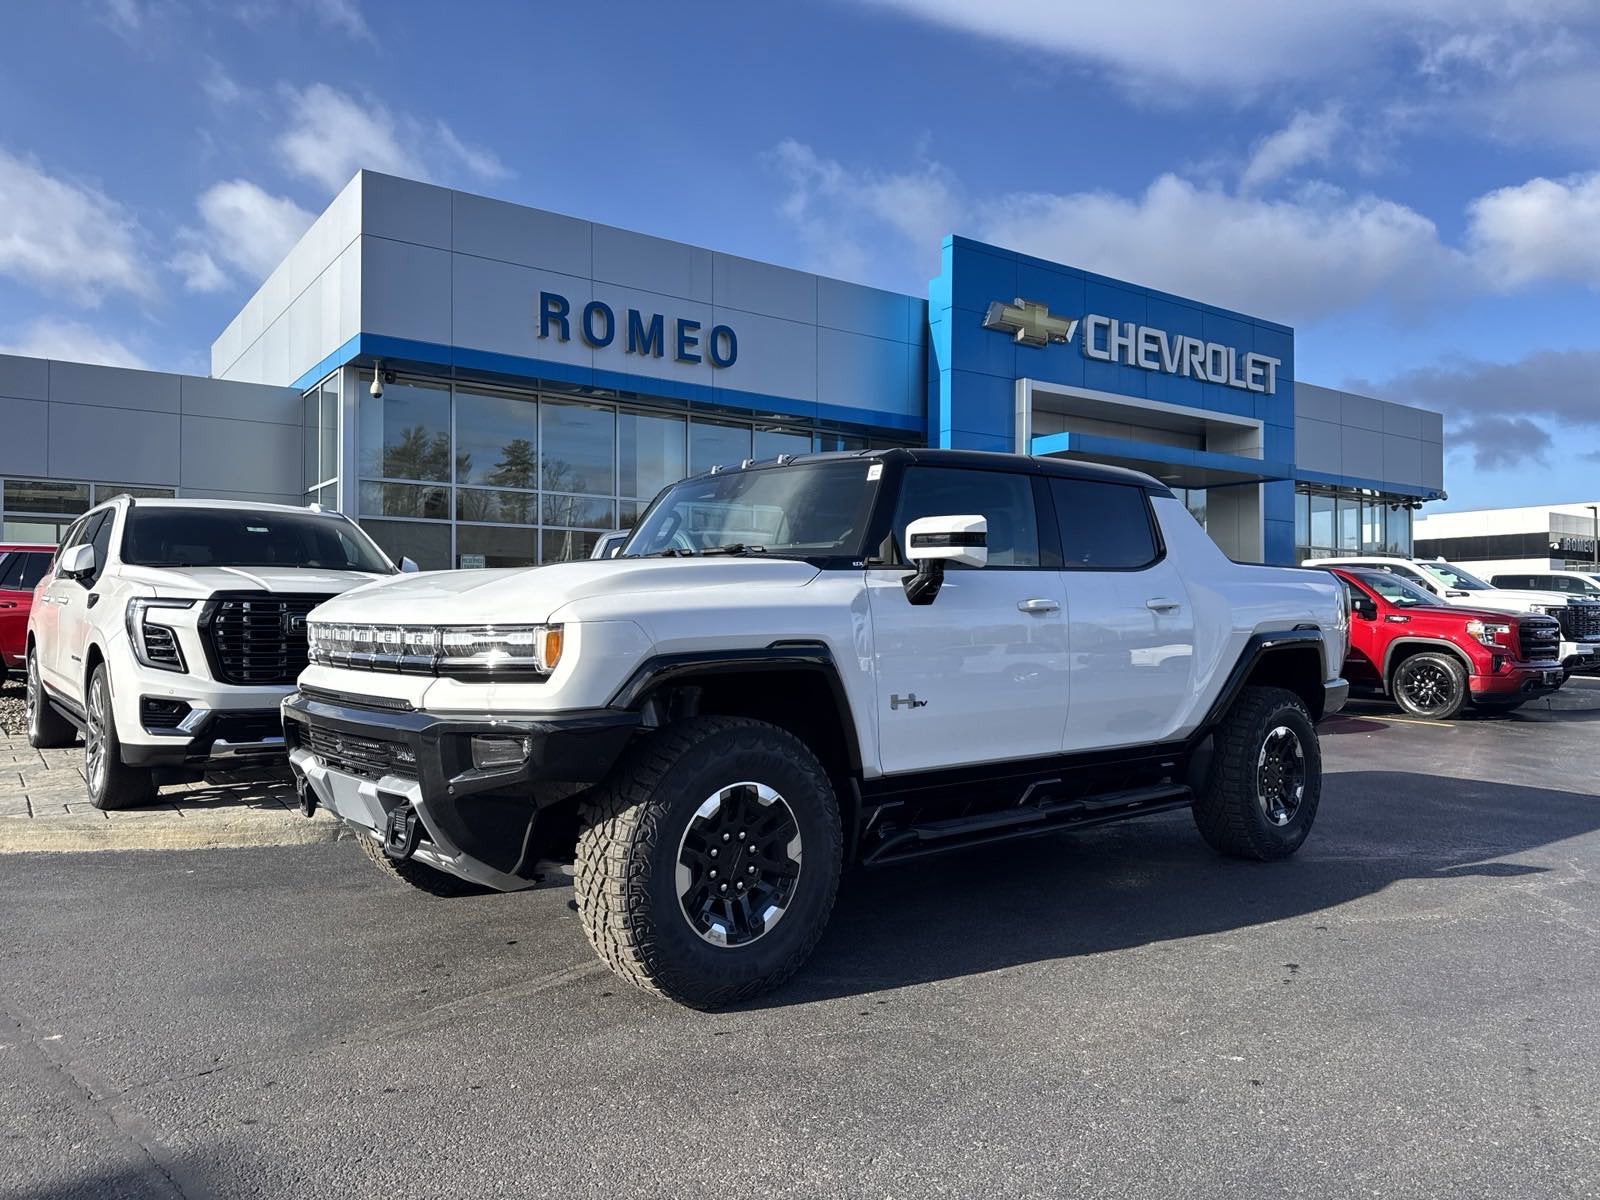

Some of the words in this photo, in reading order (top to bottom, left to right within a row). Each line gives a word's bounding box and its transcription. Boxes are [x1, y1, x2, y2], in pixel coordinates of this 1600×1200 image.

[538, 291, 738, 368] ROMEO
[1085, 314, 1281, 394] CHEVROLET
[1566, 537, 1594, 553] ROMEO
[310, 627, 424, 645] UMMER
